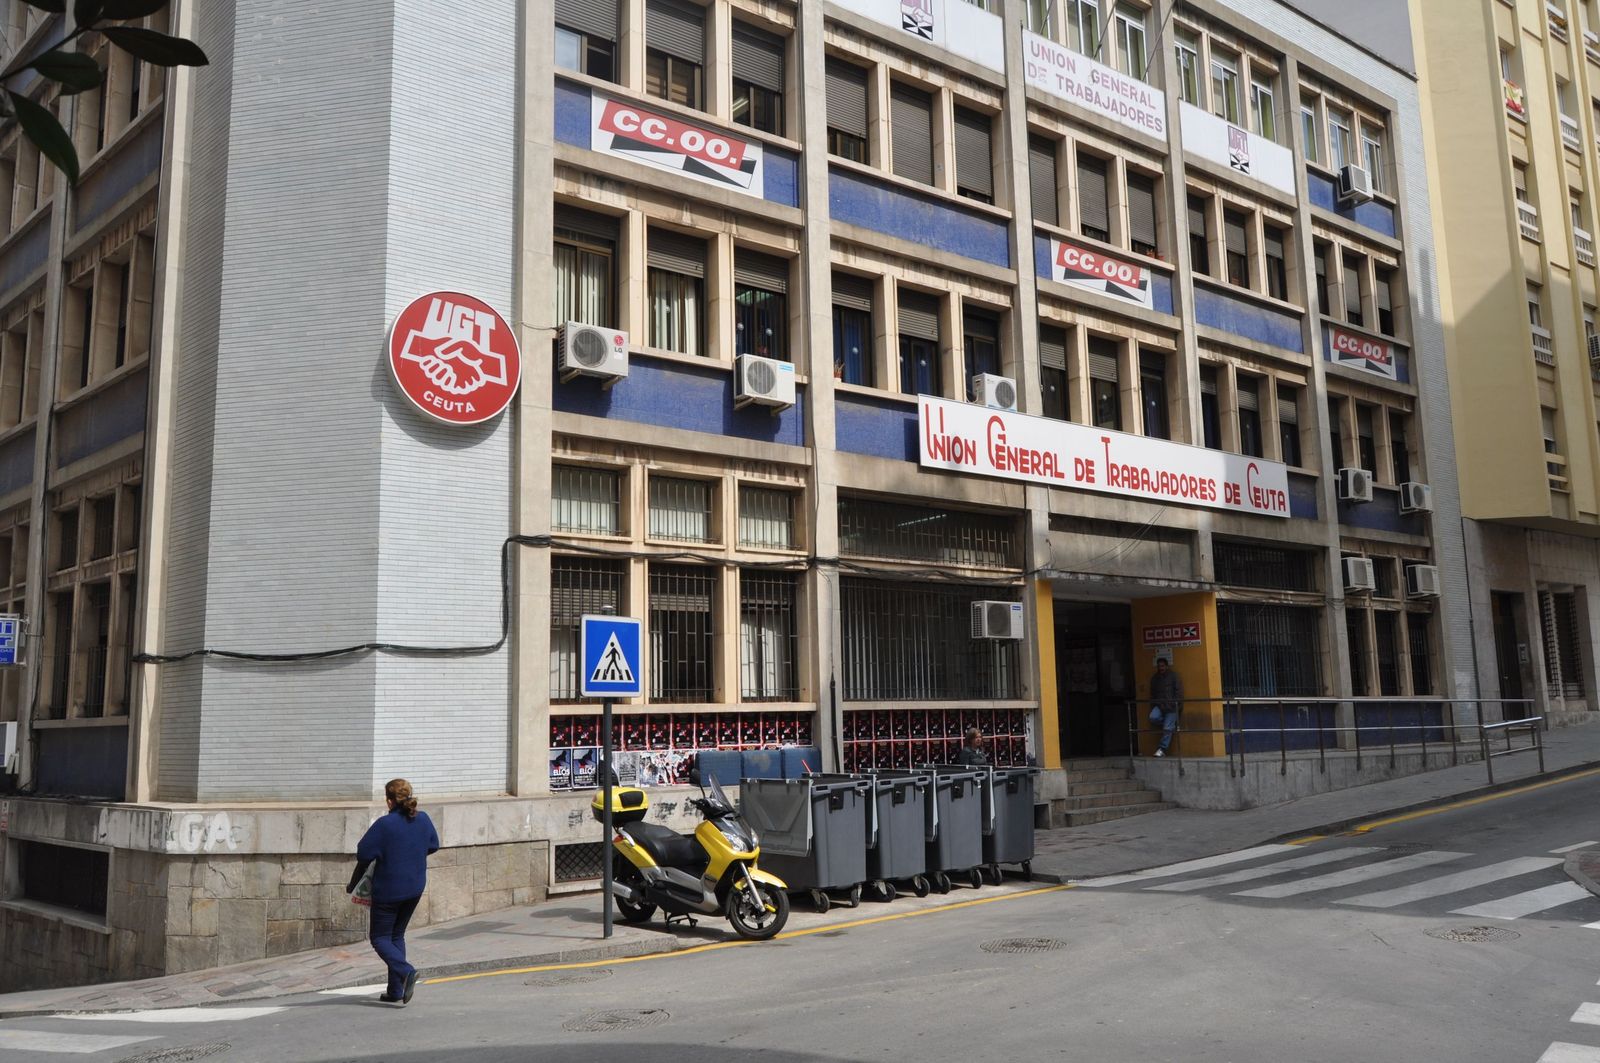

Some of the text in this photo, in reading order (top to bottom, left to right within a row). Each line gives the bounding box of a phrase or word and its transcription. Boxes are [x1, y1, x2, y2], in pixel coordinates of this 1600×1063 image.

[1028, 61, 1162, 133] DE TRABAJADORES
[1031, 40, 1156, 110] UNION GENERAL
[613, 109, 737, 164] CC.OO.
[1063, 248, 1137, 285] CC.OO.
[422, 297, 496, 353] UGT
[1337, 334, 1385, 361] CC.OO.
[423, 390, 476, 413] CEUTA
[925, 403, 1286, 512] UNION GENERAL DE TRABAJADORES DE CEUTA
[1145, 628, 1181, 640] CCOO
